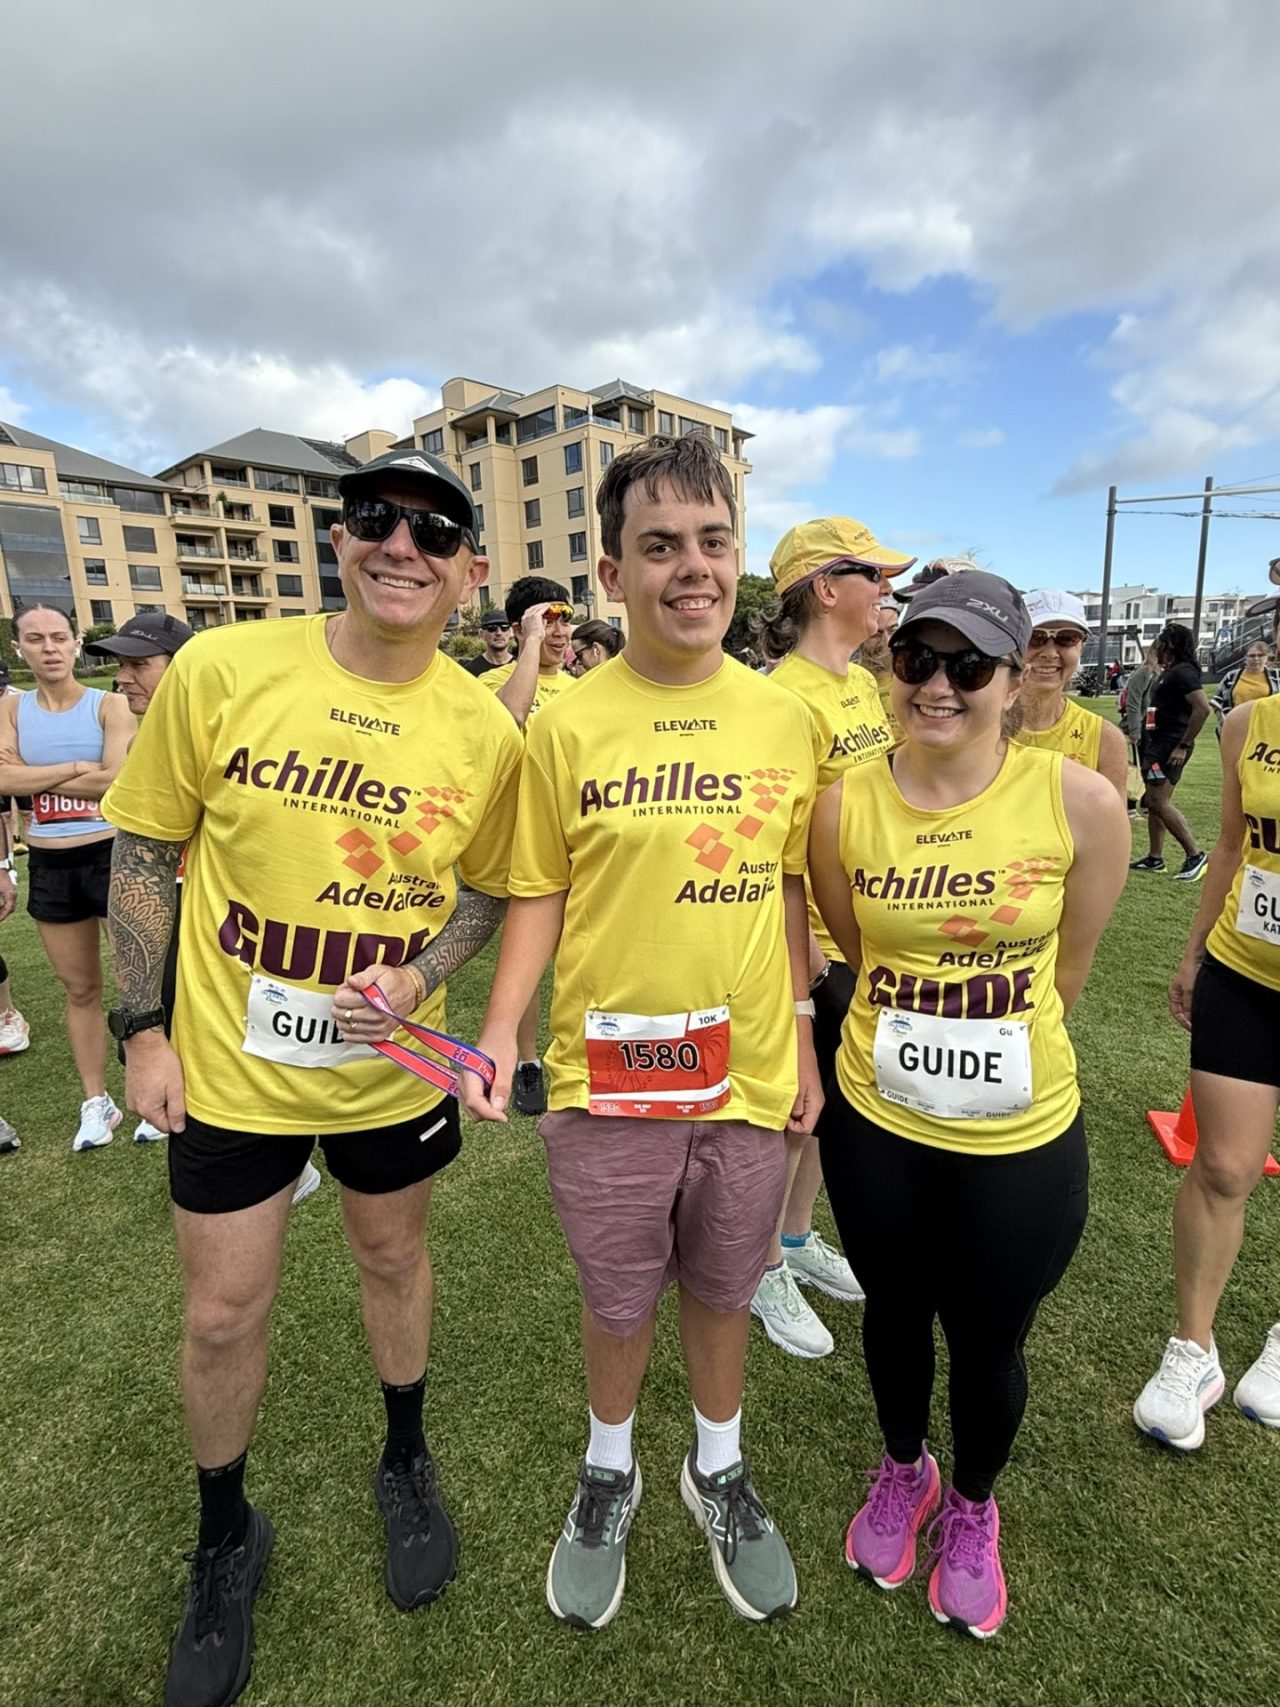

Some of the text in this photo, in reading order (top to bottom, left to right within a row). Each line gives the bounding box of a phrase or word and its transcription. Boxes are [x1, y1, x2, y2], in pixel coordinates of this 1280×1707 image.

[828, 723, 889, 758] Achilles
[223, 747, 412, 815] Achilles
[581, 762, 742, 817] Achilles
[283, 797, 401, 829] INTERNATIONAL
[632, 805, 742, 818] INTERNATIONAL
[315, 881, 446, 912] Adelaide
[674, 876, 775, 903] Adelai
[851, 864, 996, 899] Achilles
[887, 898, 996, 911] INTERNATIONAL
[867, 965, 1036, 1019] GUIDE
[699, 1014, 717, 1025] 10K
[619, 1041, 699, 1071] 1580
[898, 1042, 1003, 1084] GUIDE
